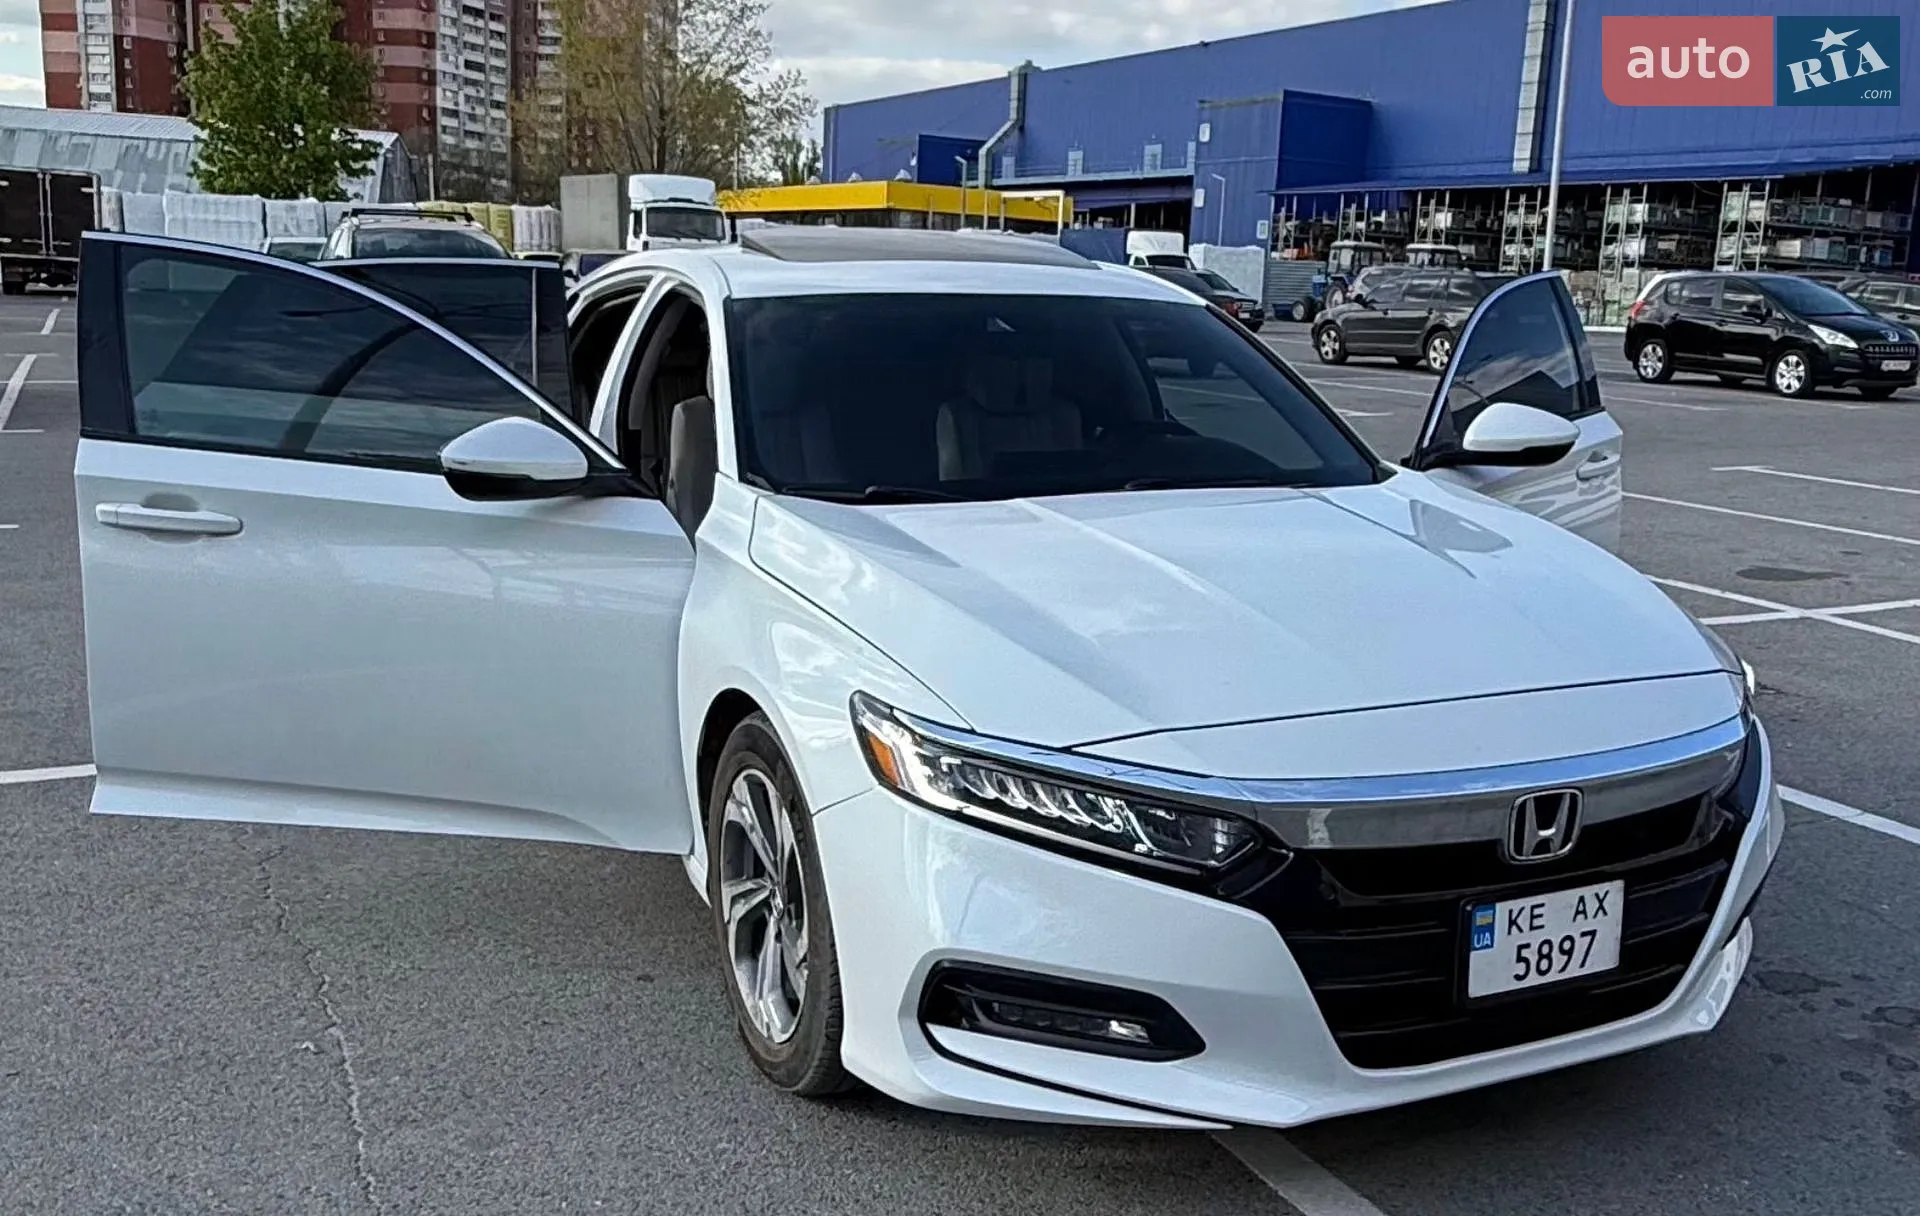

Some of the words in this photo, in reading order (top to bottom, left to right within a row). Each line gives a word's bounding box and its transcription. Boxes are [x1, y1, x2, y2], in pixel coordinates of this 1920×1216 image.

[1507, 903, 1546, 936] KE
[1572, 890, 1610, 923] AX
[1474, 932, 1492, 948] UA
[1513, 929, 1598, 981] 5897
